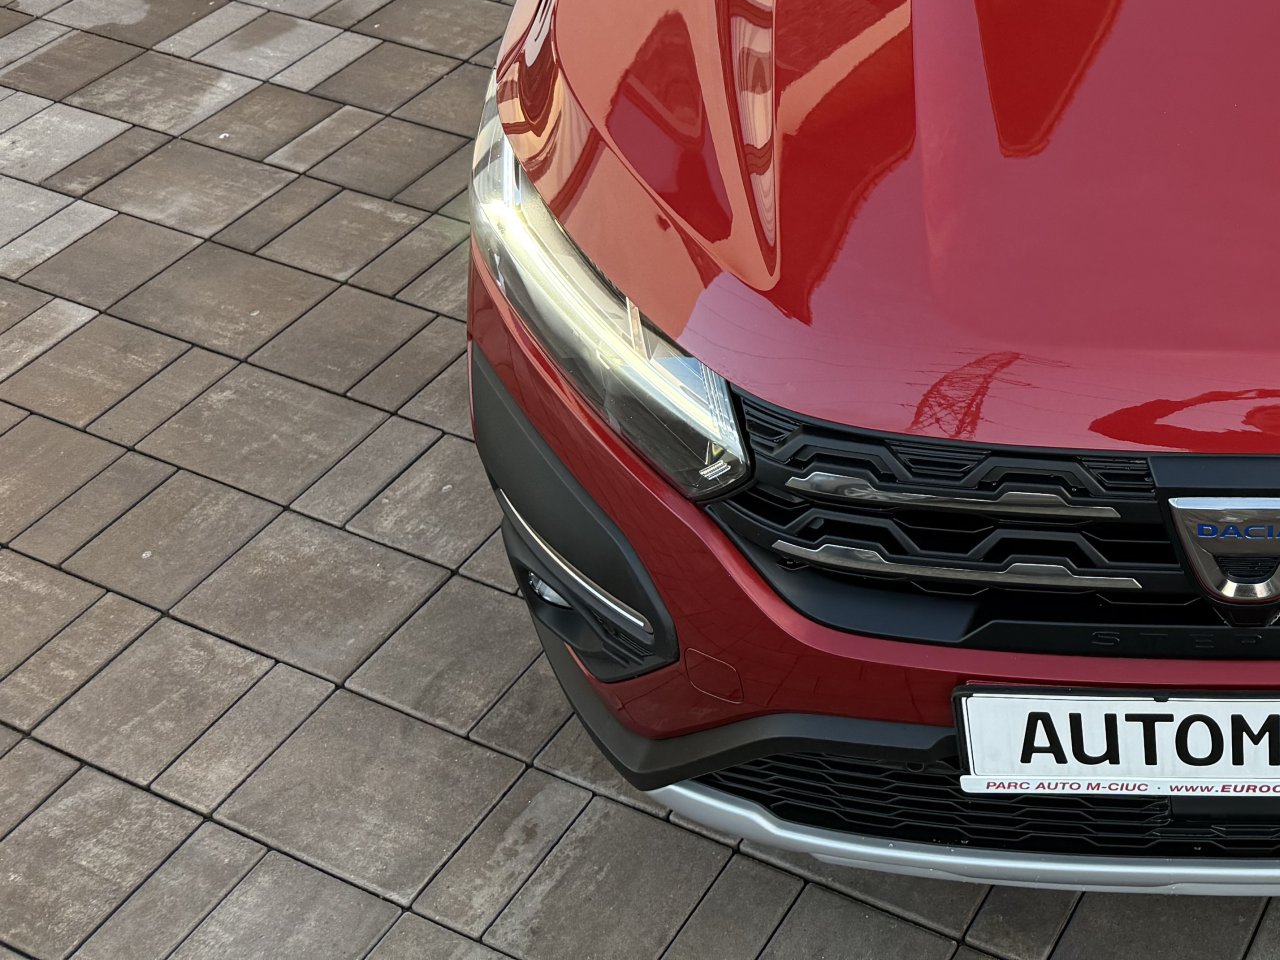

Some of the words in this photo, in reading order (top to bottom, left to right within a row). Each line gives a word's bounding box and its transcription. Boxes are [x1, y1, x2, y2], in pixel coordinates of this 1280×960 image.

[985, 781, 1031, 791] PARC
[1035, 781, 1082, 791] AUTO
[1086, 782, 1149, 792] M-CIUC
